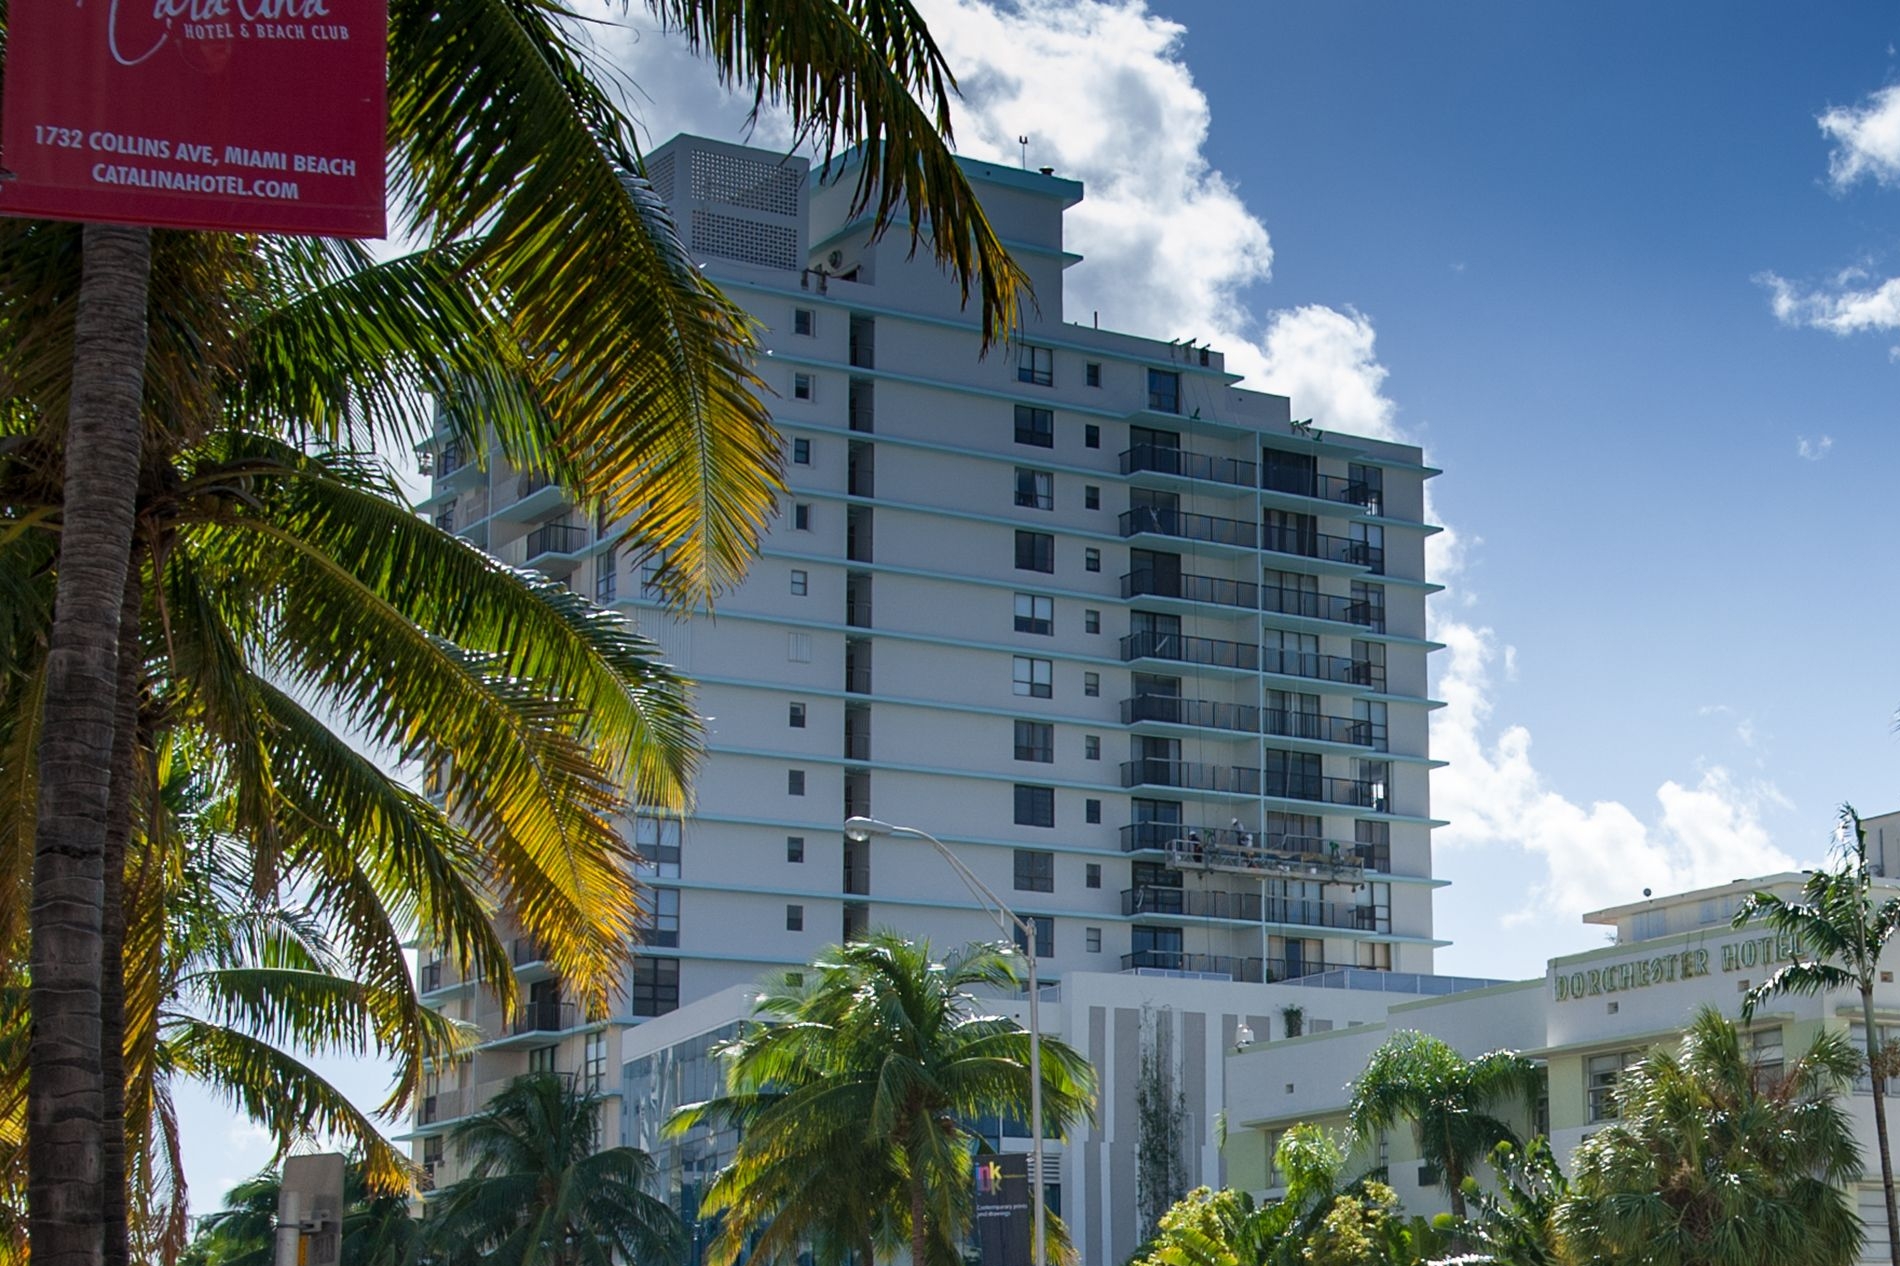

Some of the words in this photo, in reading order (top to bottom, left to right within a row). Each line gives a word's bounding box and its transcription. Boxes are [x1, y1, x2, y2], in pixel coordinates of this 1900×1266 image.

[184, 23, 234, 39] HOTEL
[240, 24, 250, 38] &
[256, 23, 305, 40] BEACH
[312, 25, 350, 40] CLUB
[35, 125, 82, 149] 1732
[89, 132, 170, 159] COLLINS
[176, 144, 219, 167] AVE,
[224, 147, 286, 171] MIAMI
[294, 155, 356, 176] BEACH
[92, 163, 299, 200] CATALINAHOTEL.COM
[1555, 949, 1709, 1001] DORCHESTER
[1721, 934, 1805, 972] HOTEL
[975, 1161, 1002, 1179] ink
